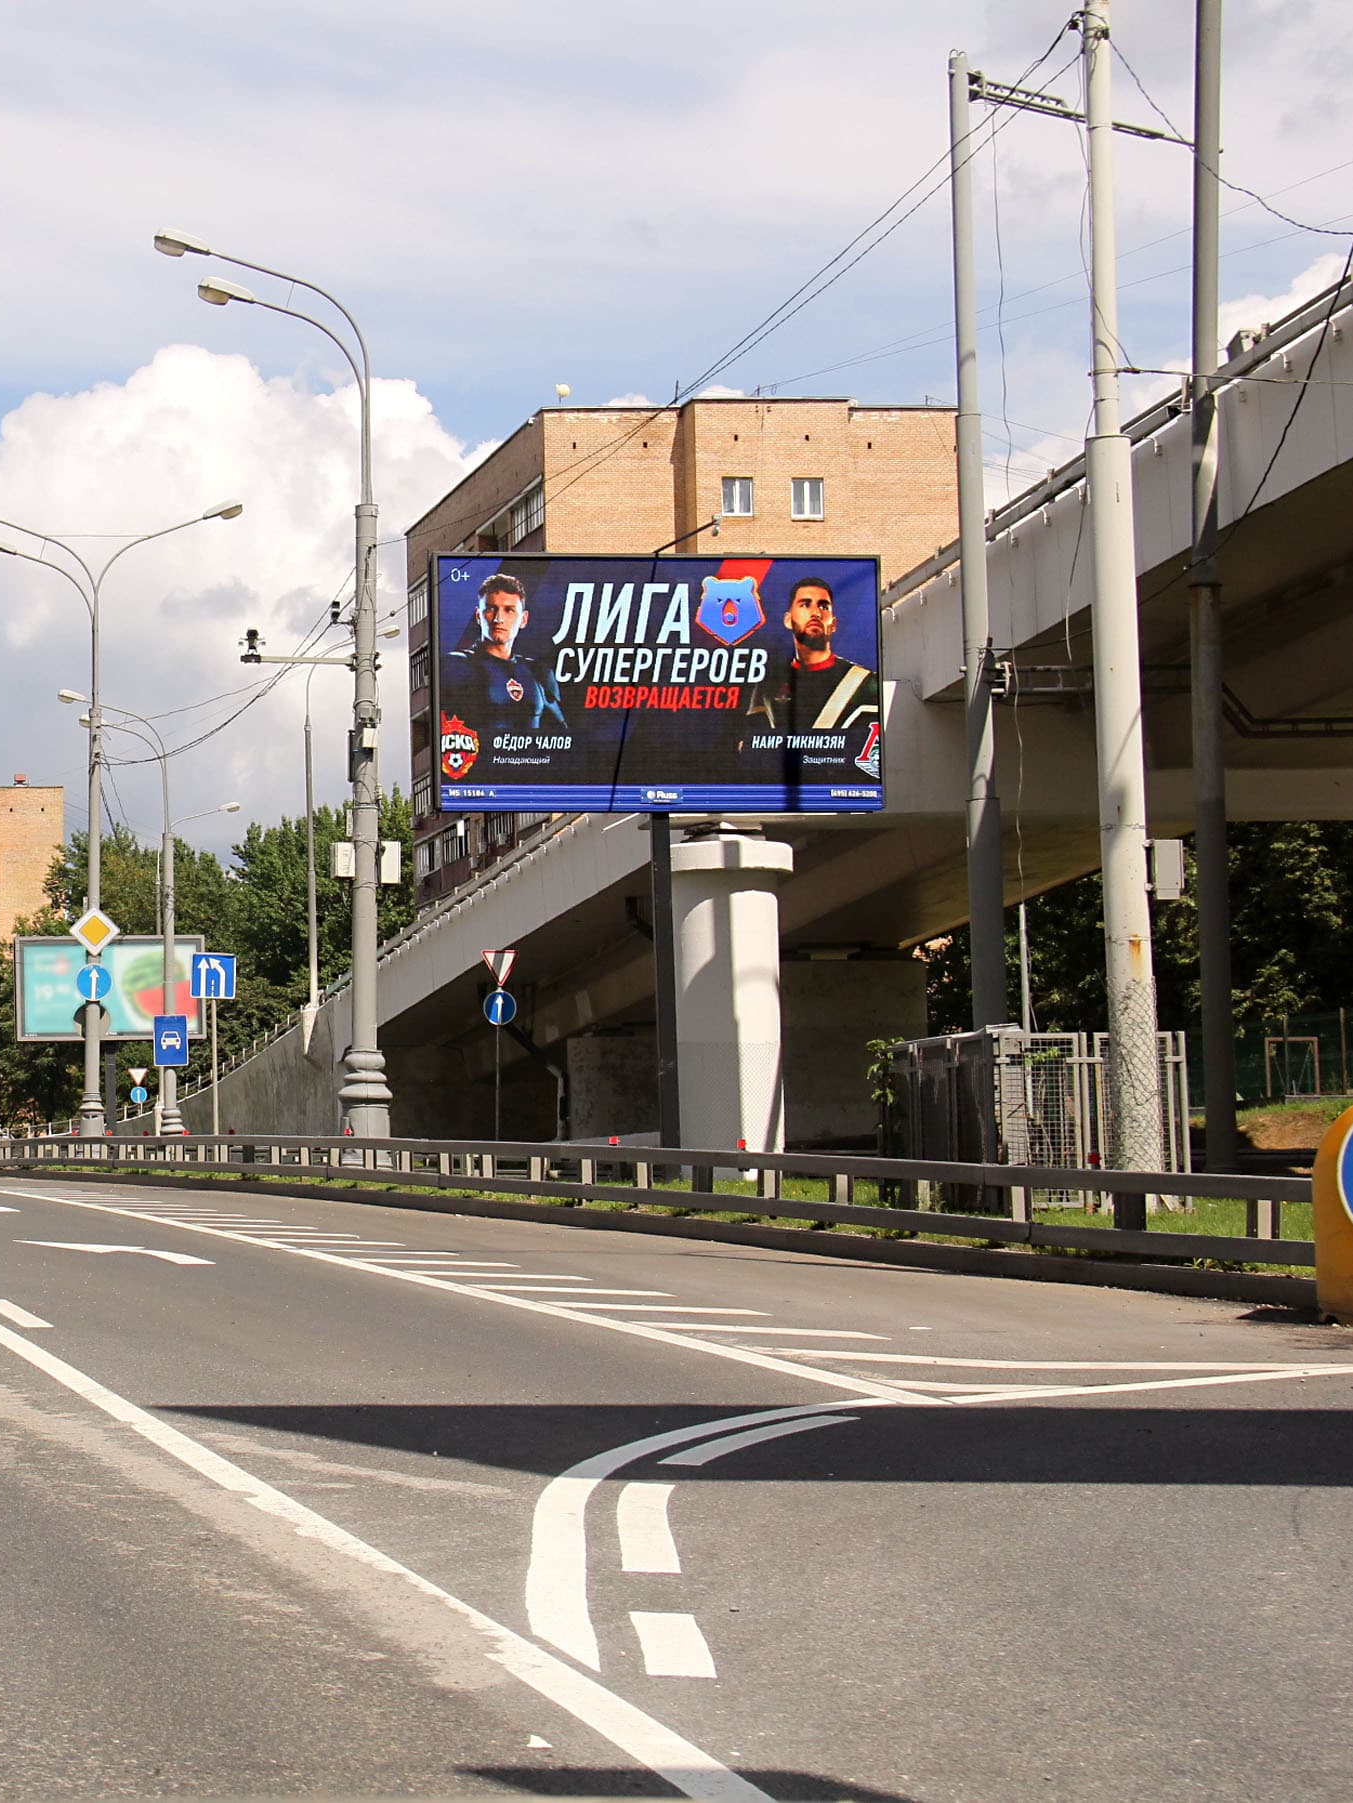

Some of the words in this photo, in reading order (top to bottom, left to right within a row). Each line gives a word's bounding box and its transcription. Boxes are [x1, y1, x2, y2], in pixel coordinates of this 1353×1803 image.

[450, 567, 470, 582] 0+
[552, 583, 691, 645] ЛИГА
[555, 648, 768, 684] СУПЕРГЕРОЕВ
[584, 686, 740, 712] ВОЗВРАЩАЕТСЯ
[493, 733, 532, 751] ФЁДОР
[535, 736, 572, 750] ЧАЛОВ
[751, 735, 783, 749] НАИР
[786, 735, 846, 749] ТИКНИЗЯН
[493, 755, 551, 765] Нападающий
[802, 755, 846, 765] Защитник
